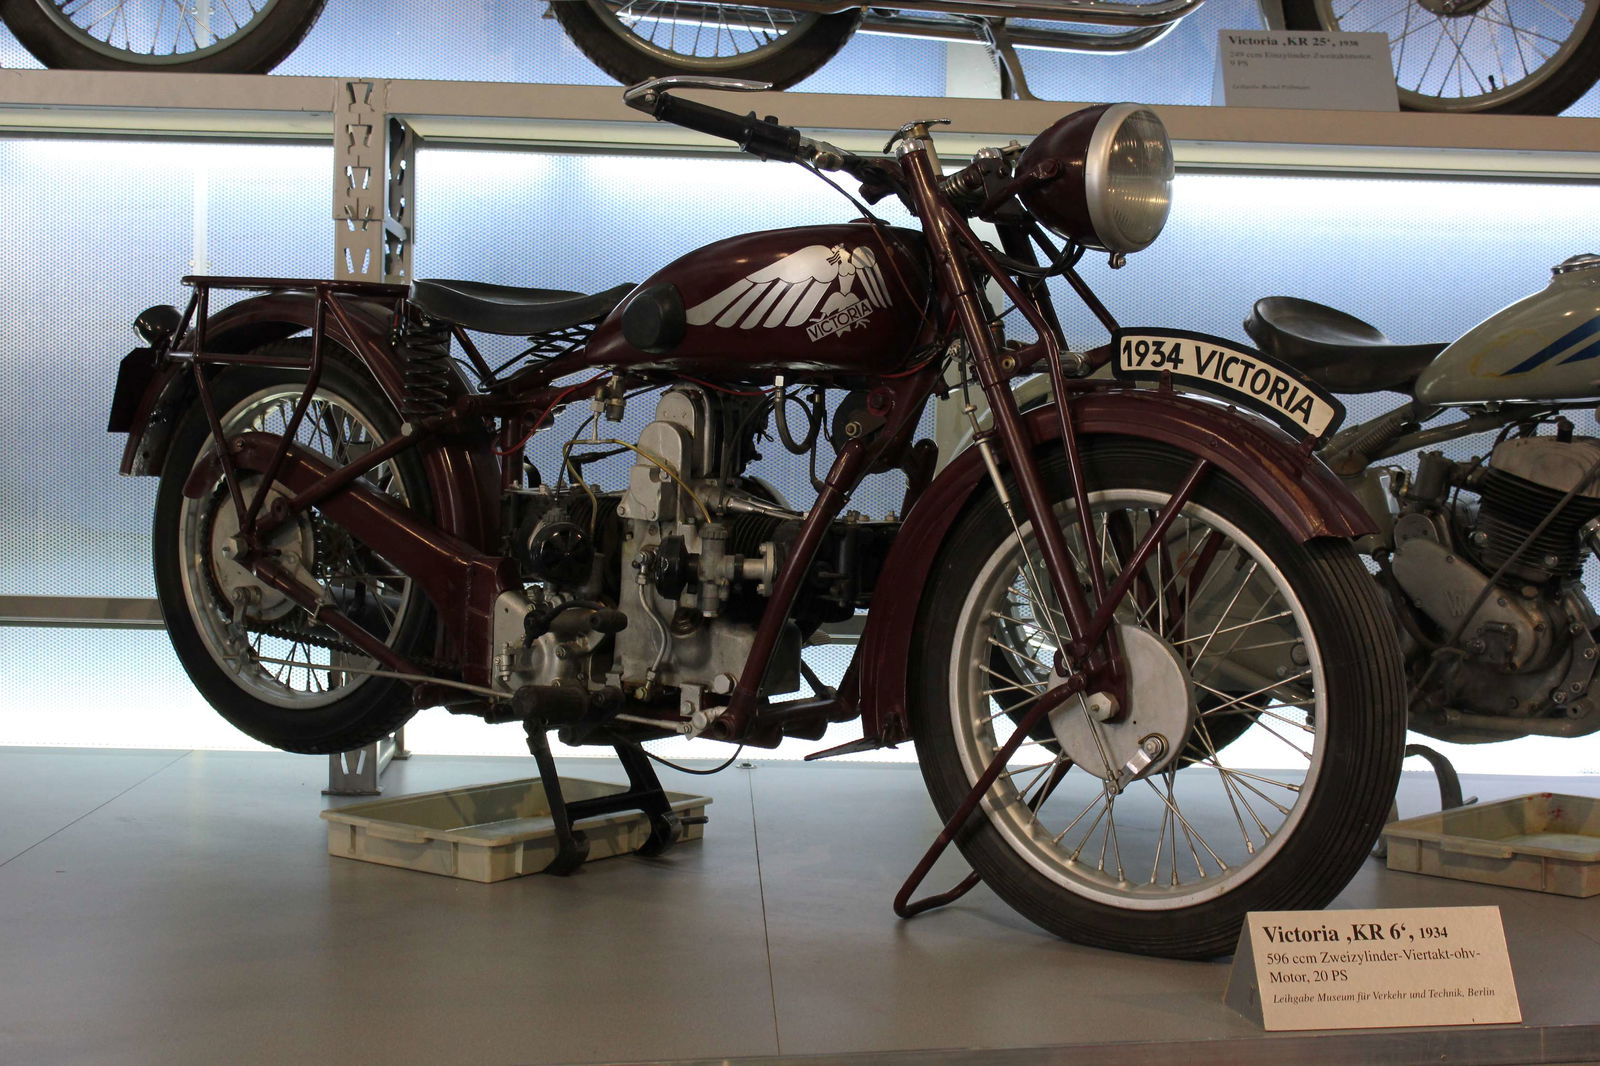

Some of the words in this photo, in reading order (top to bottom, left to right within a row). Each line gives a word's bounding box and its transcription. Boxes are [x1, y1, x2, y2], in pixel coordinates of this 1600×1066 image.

[1229, 35, 1278, 46] Victoria
[809, 302, 872, 340] VICTORIA
[1122, 340, 1184, 370] 1934
[1195, 345, 1315, 424] VICTORIA
[1262, 925, 1340, 943] Victoria
[1419, 926, 1449, 939] 1934
[1266, 952, 1290, 965] 596
[1292, 955, 1319, 965] ccm
[1320, 948, 1481, 967] Zweizylinder-Viertakt-ohv-
[1269, 970, 1311, 984] Motor,
[1313, 970, 1329, 982] 20
[1331, 969, 1349, 982] PS
[1272, 993, 1315, 1004] Leihgabe
[1317, 992, 1355, 1002] Museum
[1355, 991, 1372, 1003] für
[1373, 989, 1407, 1000] Verkehr
[1409, 989, 1427, 999] und
[1467, 986, 1496, 997] Berlin
